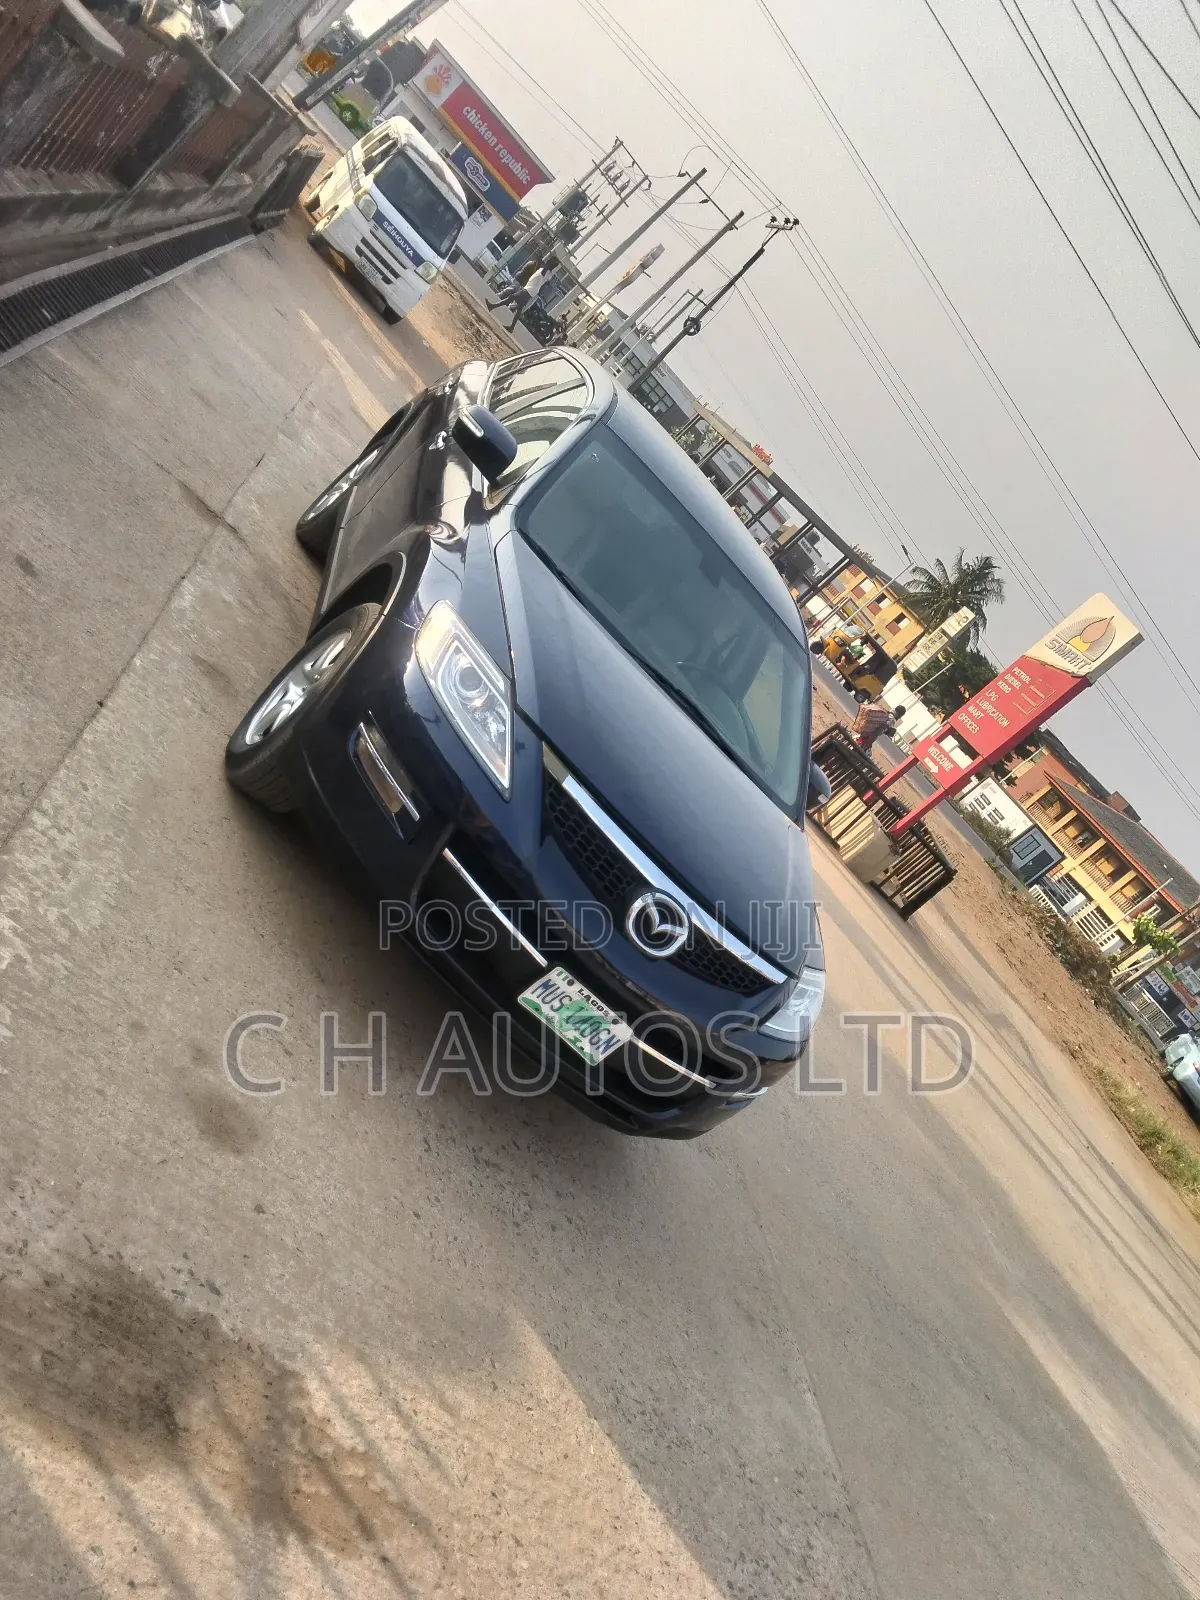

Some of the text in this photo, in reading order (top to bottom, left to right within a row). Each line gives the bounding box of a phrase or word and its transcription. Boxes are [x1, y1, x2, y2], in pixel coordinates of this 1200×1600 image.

[463, 106, 531, 184] chicken republic
[1004, 673, 1021, 690] DIESEL
[1011, 666, 1032, 684] PETROL
[985, 688, 999, 702] LPG
[996, 680, 1012, 694] KERO
[966, 705, 984, 720] MART
[975, 697, 1010, 728] LUBRICATION
[957, 713, 980, 734] OFFICES
[927, 745, 954, 772] WELCOME
[577, 988, 611, 1017] LAGOS
